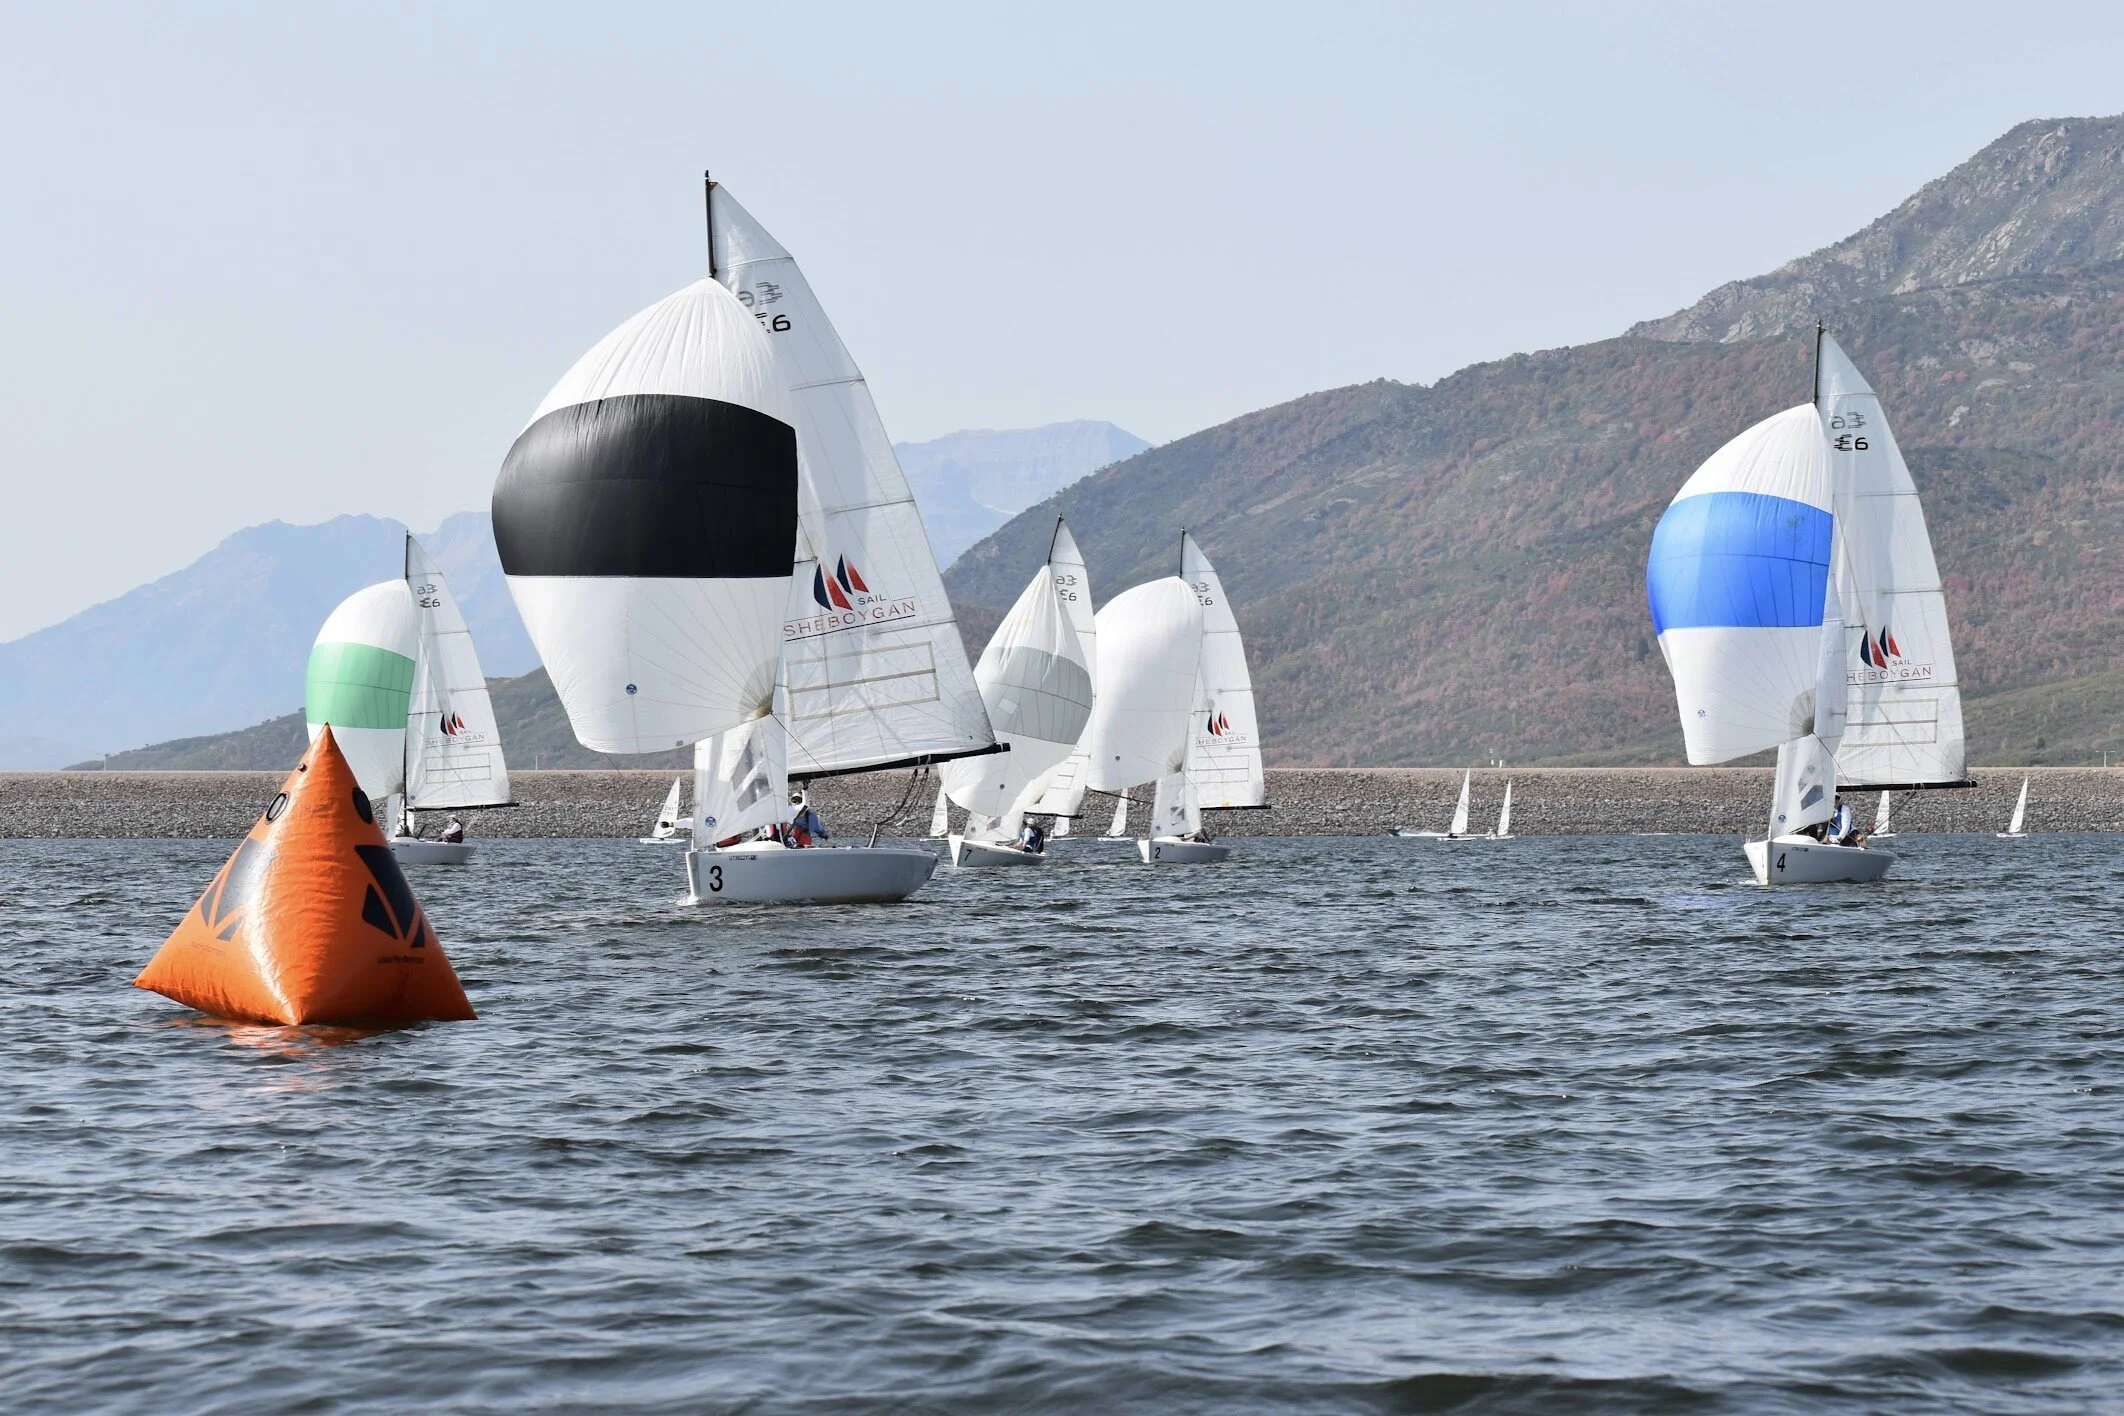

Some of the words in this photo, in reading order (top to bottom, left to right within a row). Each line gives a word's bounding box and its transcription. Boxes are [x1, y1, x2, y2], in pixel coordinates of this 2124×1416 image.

[858, 594, 887, 606] SAIL
[783, 601, 916, 637] SHEBOYGAN
[1892, 659, 1912, 667] SAIL
[1847, 666, 1932, 683] HEBOYGAN
[964, 849, 973, 862] 7
[1154, 847, 1161, 859] 2
[1776, 852, 1786, 873] 4
[709, 864, 724, 893] 3
